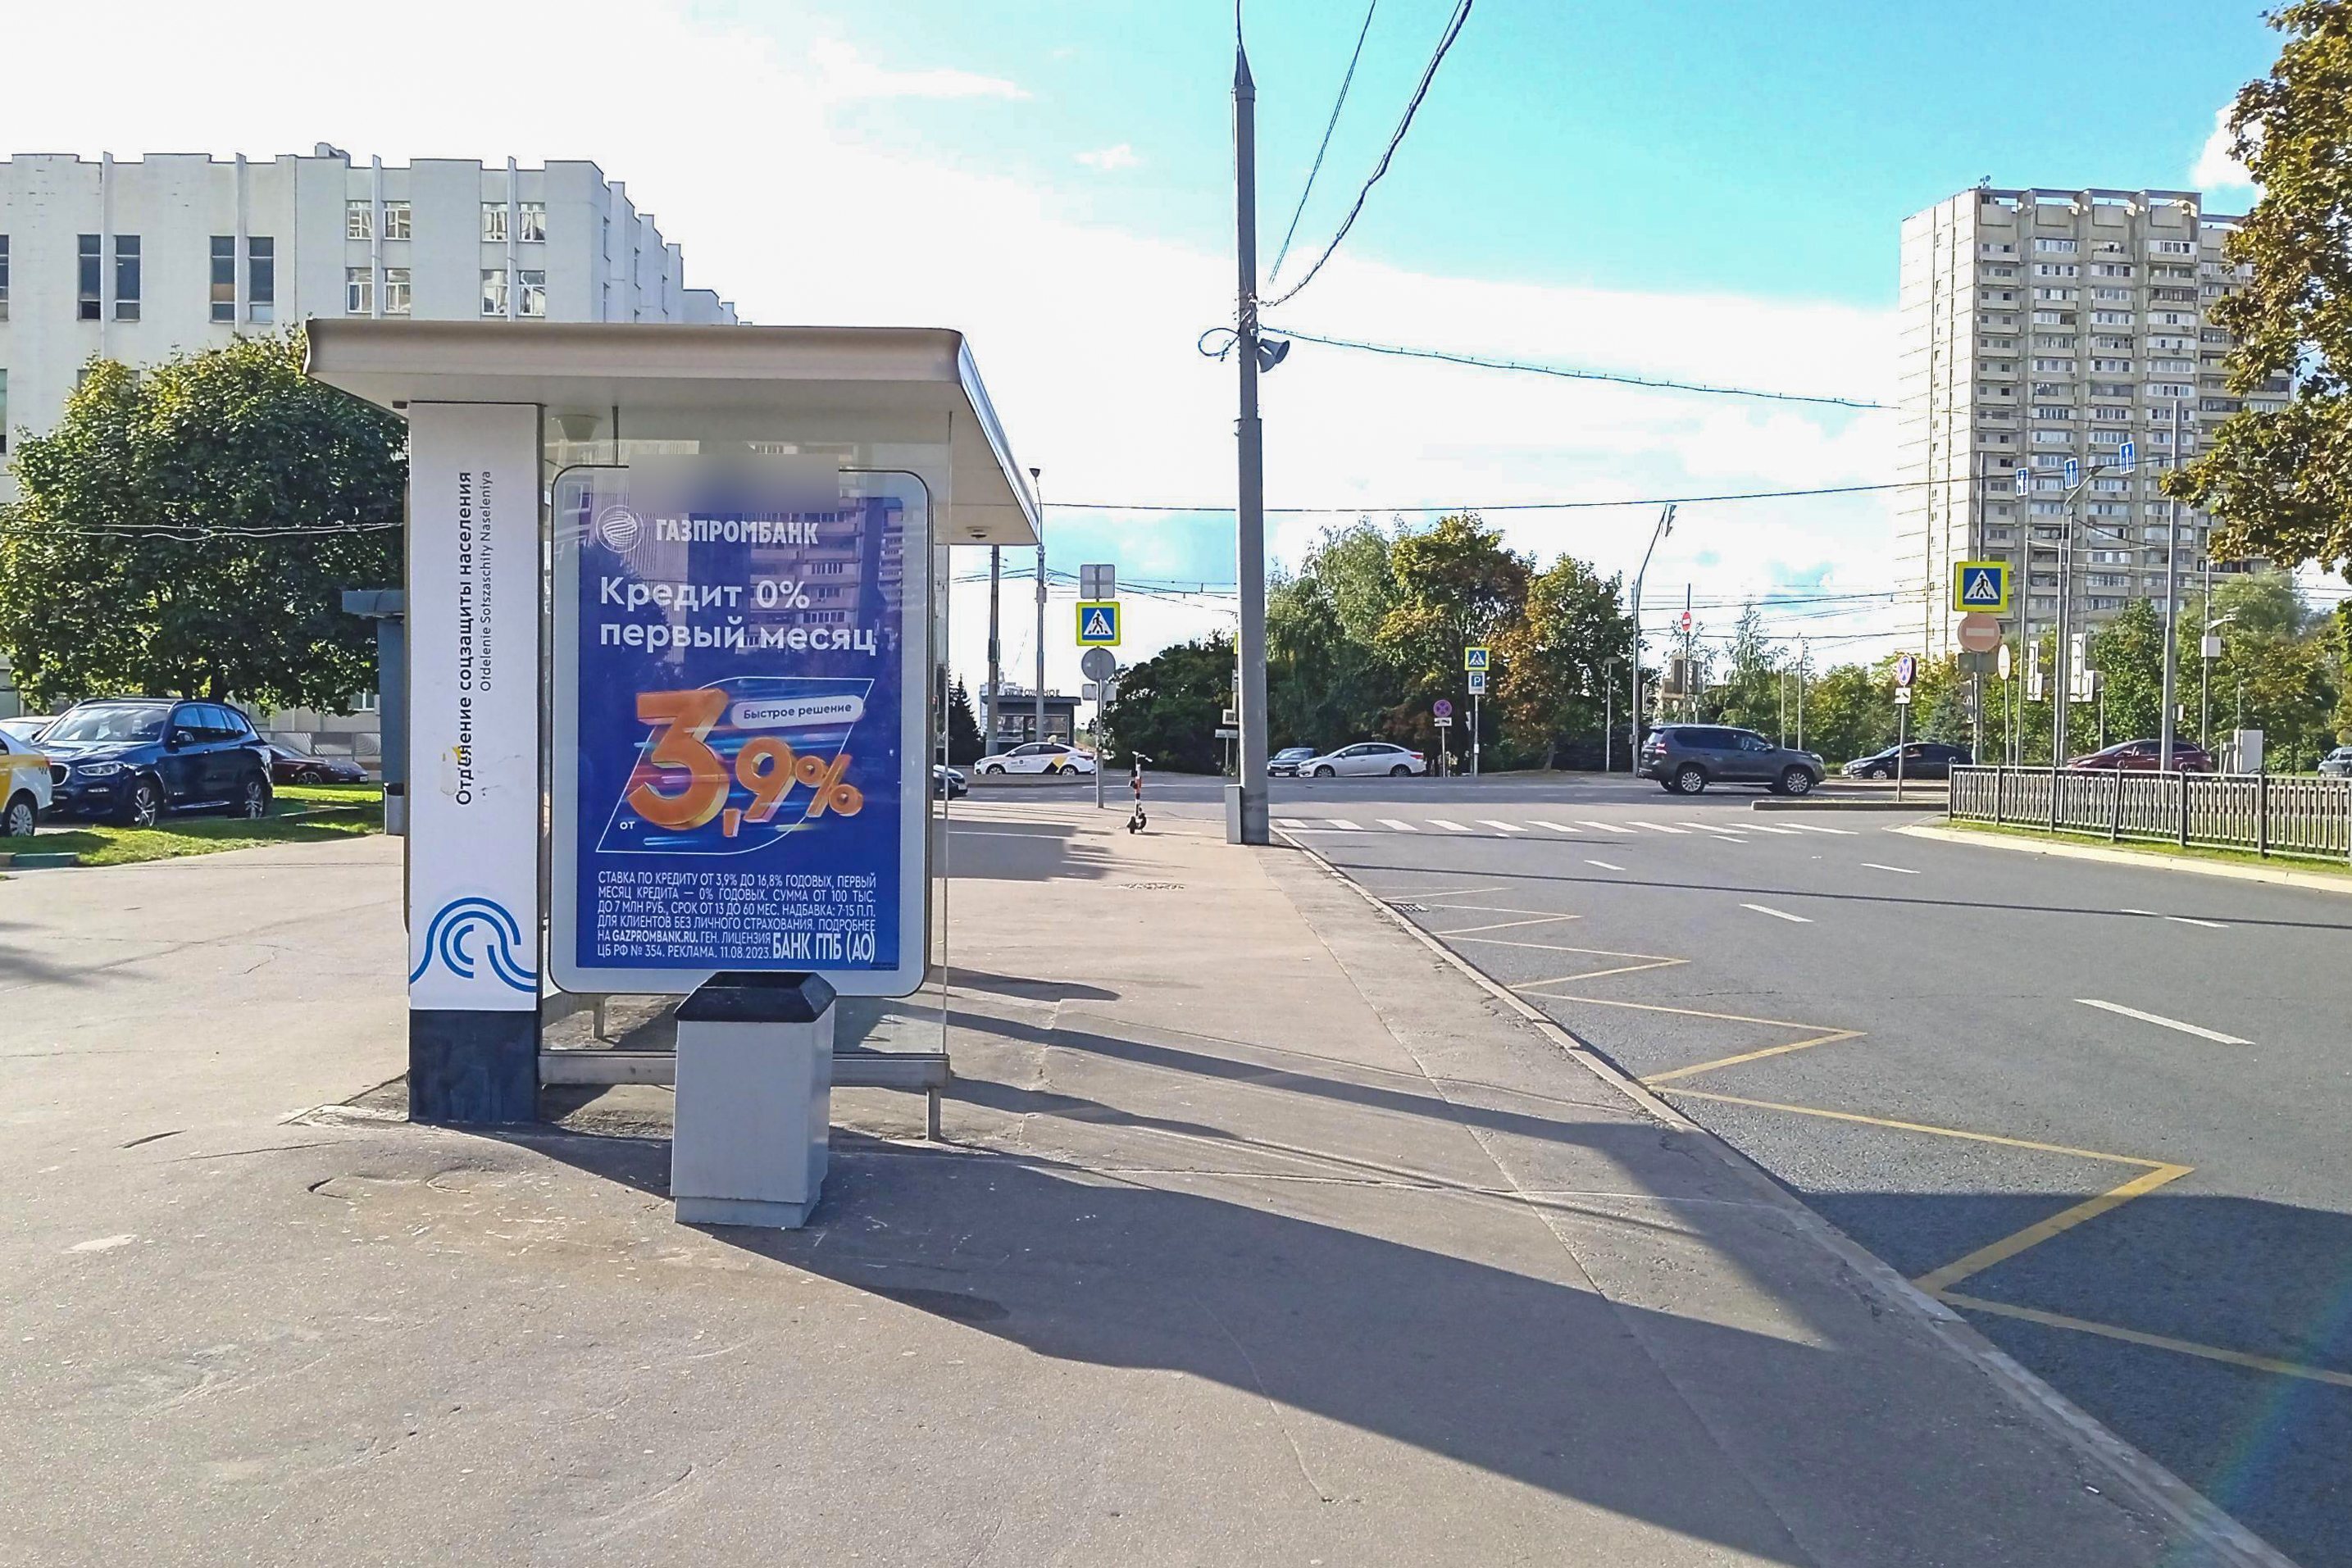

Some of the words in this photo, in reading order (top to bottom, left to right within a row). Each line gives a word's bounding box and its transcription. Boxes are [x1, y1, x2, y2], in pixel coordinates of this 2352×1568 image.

[480, 471, 493, 541] Naseleniya
[459, 472, 471, 575] населения
[655, 519, 819, 545] ГАЗПРОМБАНК
[480, 545, 493, 624] Sotszaschity
[601, 576, 742, 612] Кредит
[756, 579, 810, 609] 0%
[460, 581, 474, 691] соцзащиты
[600, 616, 744, 653] первый
[760, 626, 876, 656] месяц
[480, 627, 491, 691] Otdelenie
[744, 708, 795, 720] Быстрое
[798, 703, 852, 718] решение
[627, 688, 863, 838] 3,9%
[620, 821, 635, 830] от
[598, 871, 635, 884] СТАВКА
[638, 872, 653, 884] ПО
[656, 872, 698, 886] КРЕДИТУ
[700, 873, 713, 885] ОТ
[715, 874, 738, 887] 3,9%
[739, 874, 754, 887] ДО
[757, 874, 782, 889] 16,8%
[785, 875, 835, 889] ГОДОВЫХ,
[838, 872, 876, 888] ПЕРВЫЙ
[598, 886, 631, 900] МЕСЯЦ
[636, 887, 679, 901] КРЕДИТА
[698, 889, 713, 900] 0%
[719, 889, 768, 902] ГОДОВЫХ.
[773, 890, 808, 902] СУММА
[813, 890, 826, 902] ОТ
[831, 890, 847, 902] 100
[853, 890, 876, 902] ТЫС.
[598, 901, 612, 915] ДО
[615, 901, 620, 912] 7
[622, 901, 644, 913] МЛН
[646, 902, 669, 916] РУБ.,
[671, 902, 697, 915] СРОК
[700, 902, 713, 915] ОТ
[715, 903, 724, 915] 13
[726, 903, 740, 916] ДО
[743, 903, 754, 915] 60
[757, 903, 780, 916] МЕС.
[782, 904, 835, 917] НАДБАВКА:
[838, 905, 854, 916] 7-15
[857, 905, 876, 917] П.П.
[598, 915, 616, 929] ДЛЯ
[620, 916, 671, 928] КЛИЕНТОВ
[674, 916, 691, 929] БЕЗ
[694, 917, 740, 929] ЛИЧНОГО
[744, 918, 816, 930] СТРАХОВАНИЯ.
[819, 918, 876, 932] ПОДРОБНЕЕ
[598, 929, 610, 941] НА
[612, 929, 698, 943] GAZPROMBANK.RU.
[701, 931, 720, 943] ГЕН.
[721, 932, 771, 945] ЛИЦЕНЗИЯ
[598, 944, 612, 957] ЦБ
[614, 944, 628, 957] РФ
[630, 944, 643, 956] №
[644, 945, 665, 957] 354.
[667, 945, 717, 958] РЕКЛАМА.
[720, 947, 771, 959] 11.08.2023.
[773, 932, 811, 959] БАНК
[816, 933, 842, 960] ГПБ
[847, 931, 876, 963] (АО)
